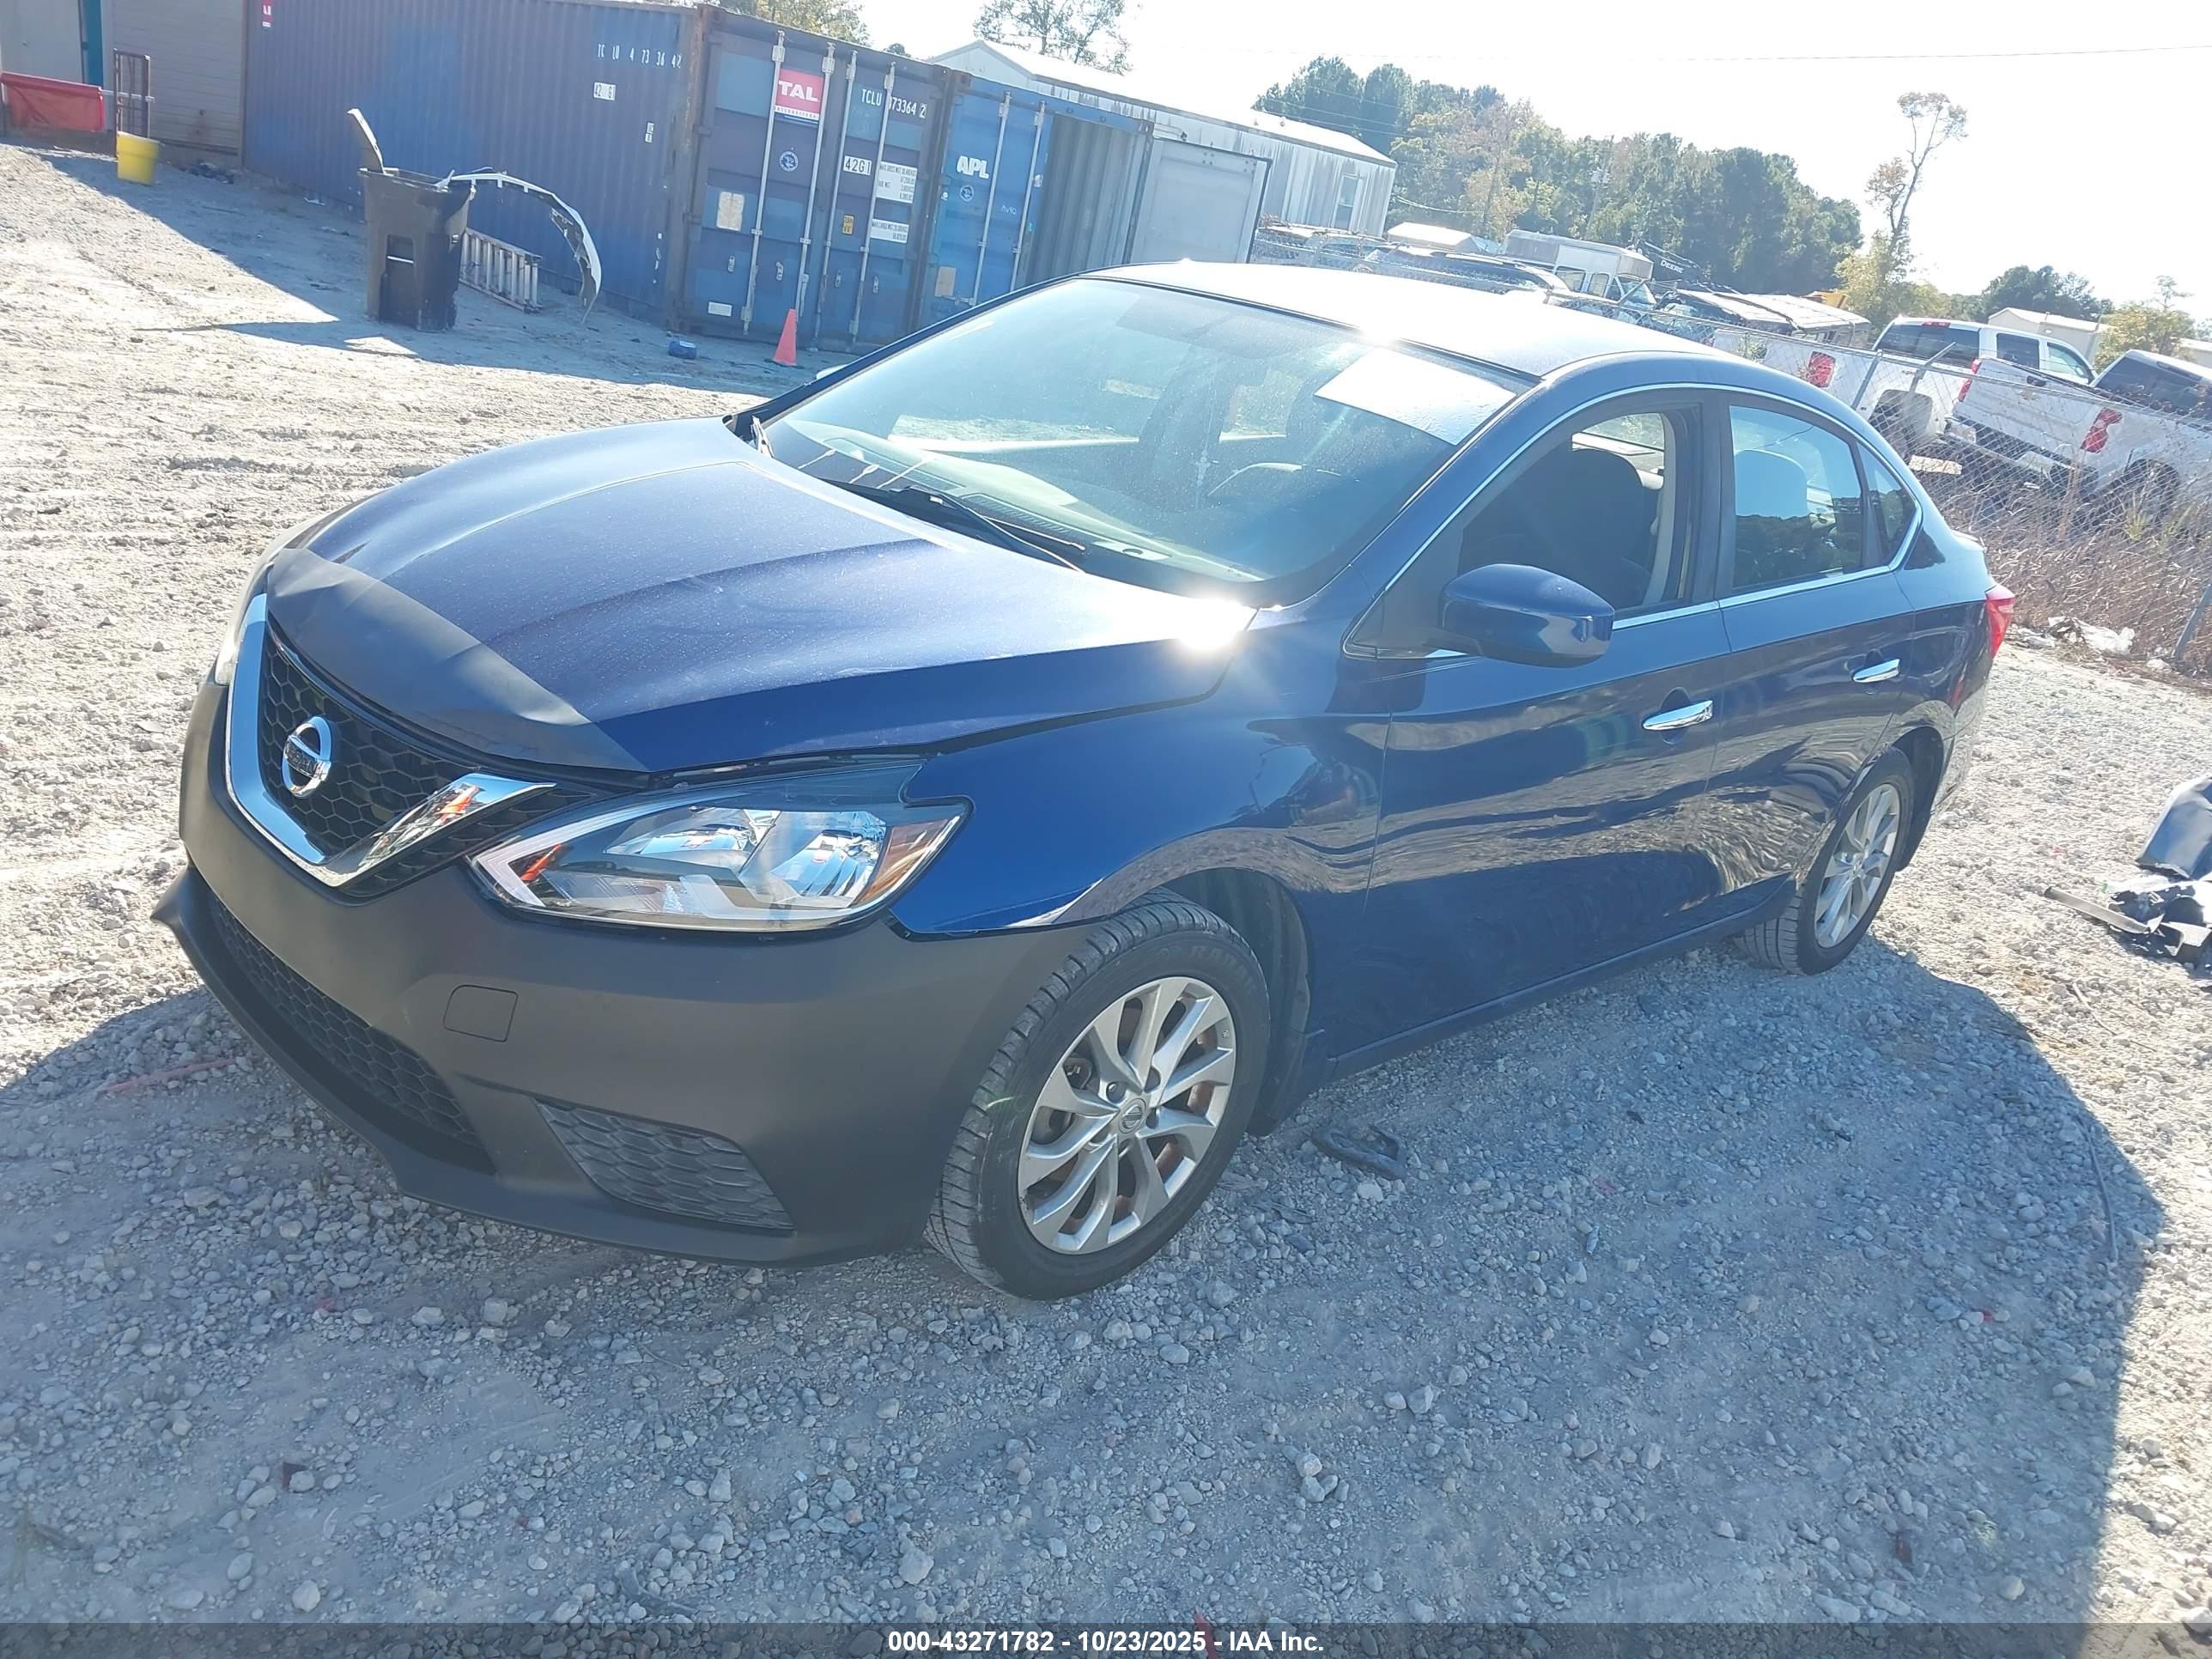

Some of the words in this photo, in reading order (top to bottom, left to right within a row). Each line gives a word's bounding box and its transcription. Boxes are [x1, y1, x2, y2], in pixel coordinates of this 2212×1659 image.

[778, 80, 818, 102] TAL
[861, 88, 883, 106] TCLU
[845, 157, 871, 174] 42G1
[957, 155, 989, 179] APL
[1661, 259, 1684, 274] DEERE
